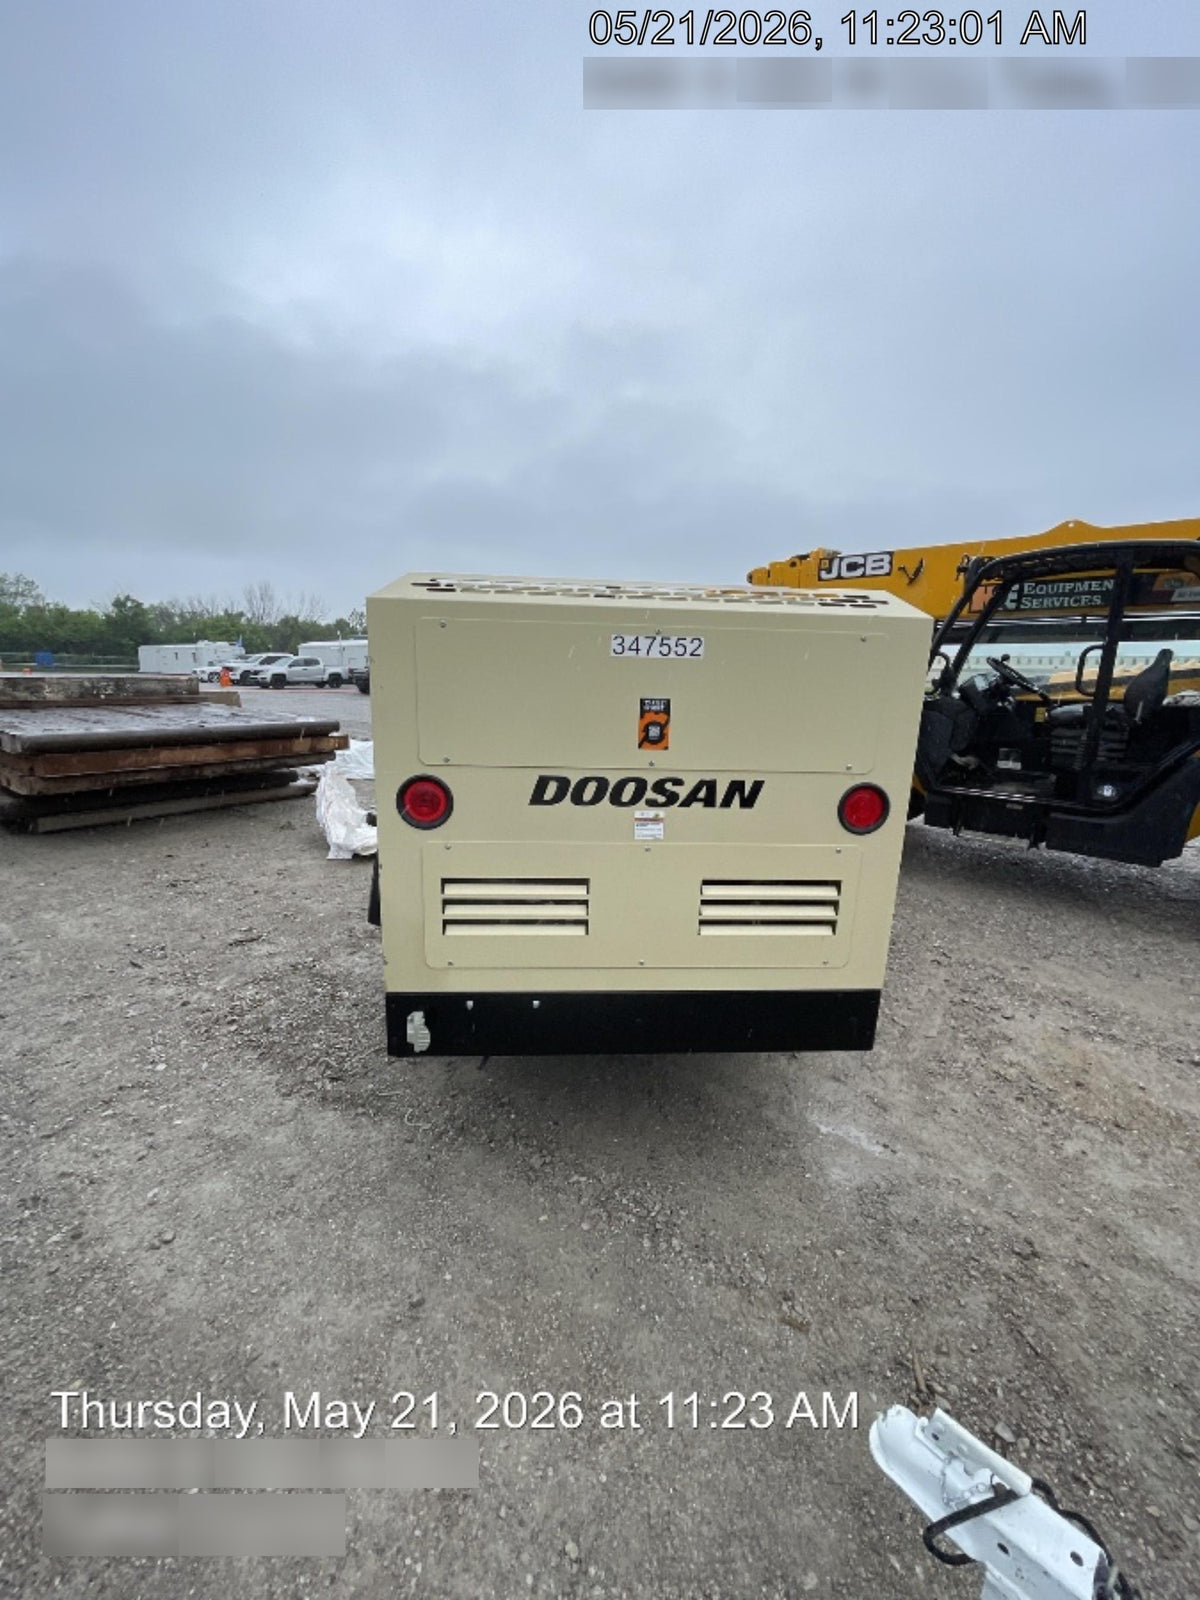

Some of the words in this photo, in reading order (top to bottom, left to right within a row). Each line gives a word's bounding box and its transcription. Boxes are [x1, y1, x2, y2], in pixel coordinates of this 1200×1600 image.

[820, 554, 891, 579] JCB
[1023, 579, 1115, 595] EQUIPMEN
[612, 635, 703, 657] 347552
[528, 775, 765, 809] DOOSAN
